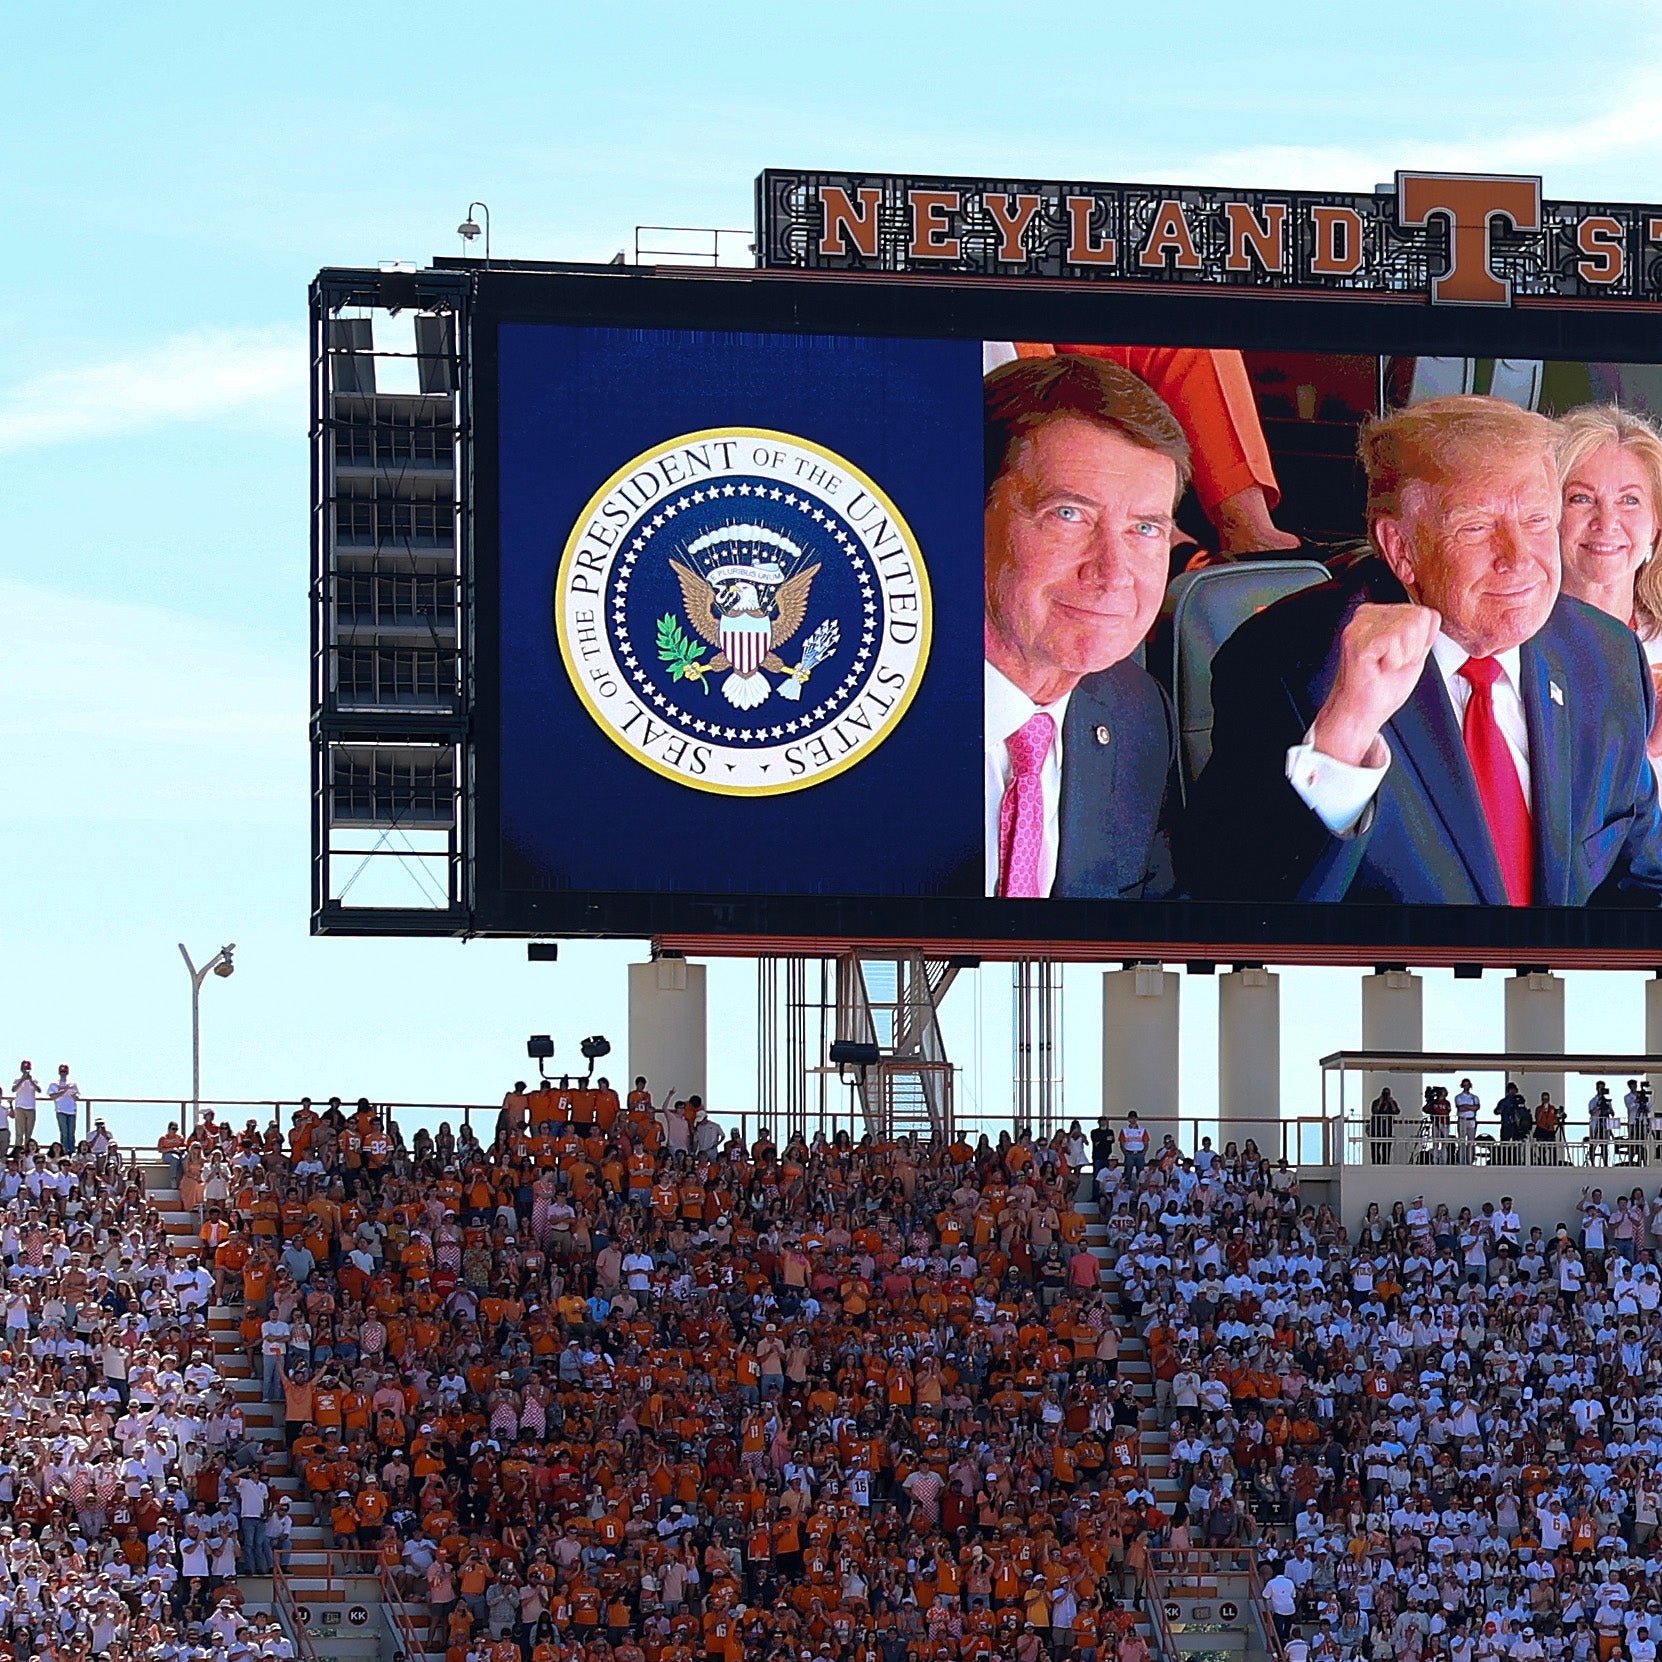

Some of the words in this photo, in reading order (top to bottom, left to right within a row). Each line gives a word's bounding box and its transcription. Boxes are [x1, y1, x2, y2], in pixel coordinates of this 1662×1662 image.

[818, 183, 1364, 277] NEYLAND
[1398, 173, 1542, 307] T
[752, 447, 786, 468] OF
[794, 457, 842, 495] THE
[571, 441, 738, 598] PRESIDENT
[844, 491, 919, 645] UNITED
[575, 608, 599, 661] THE
[589, 667, 618, 697] OF
[784, 665, 906, 776] STATES
[619, 699, 712, 775] SEAL
[1375, 1377, 1387, 1391] 16
[366, 1497, 375, 1506] T
[1578, 1524, 1590, 1537] 16
[350, 1611, 366, 1620] KK
[1164, 1607, 1179, 1616] KK
[1222, 1607, 1235, 1616] LL
